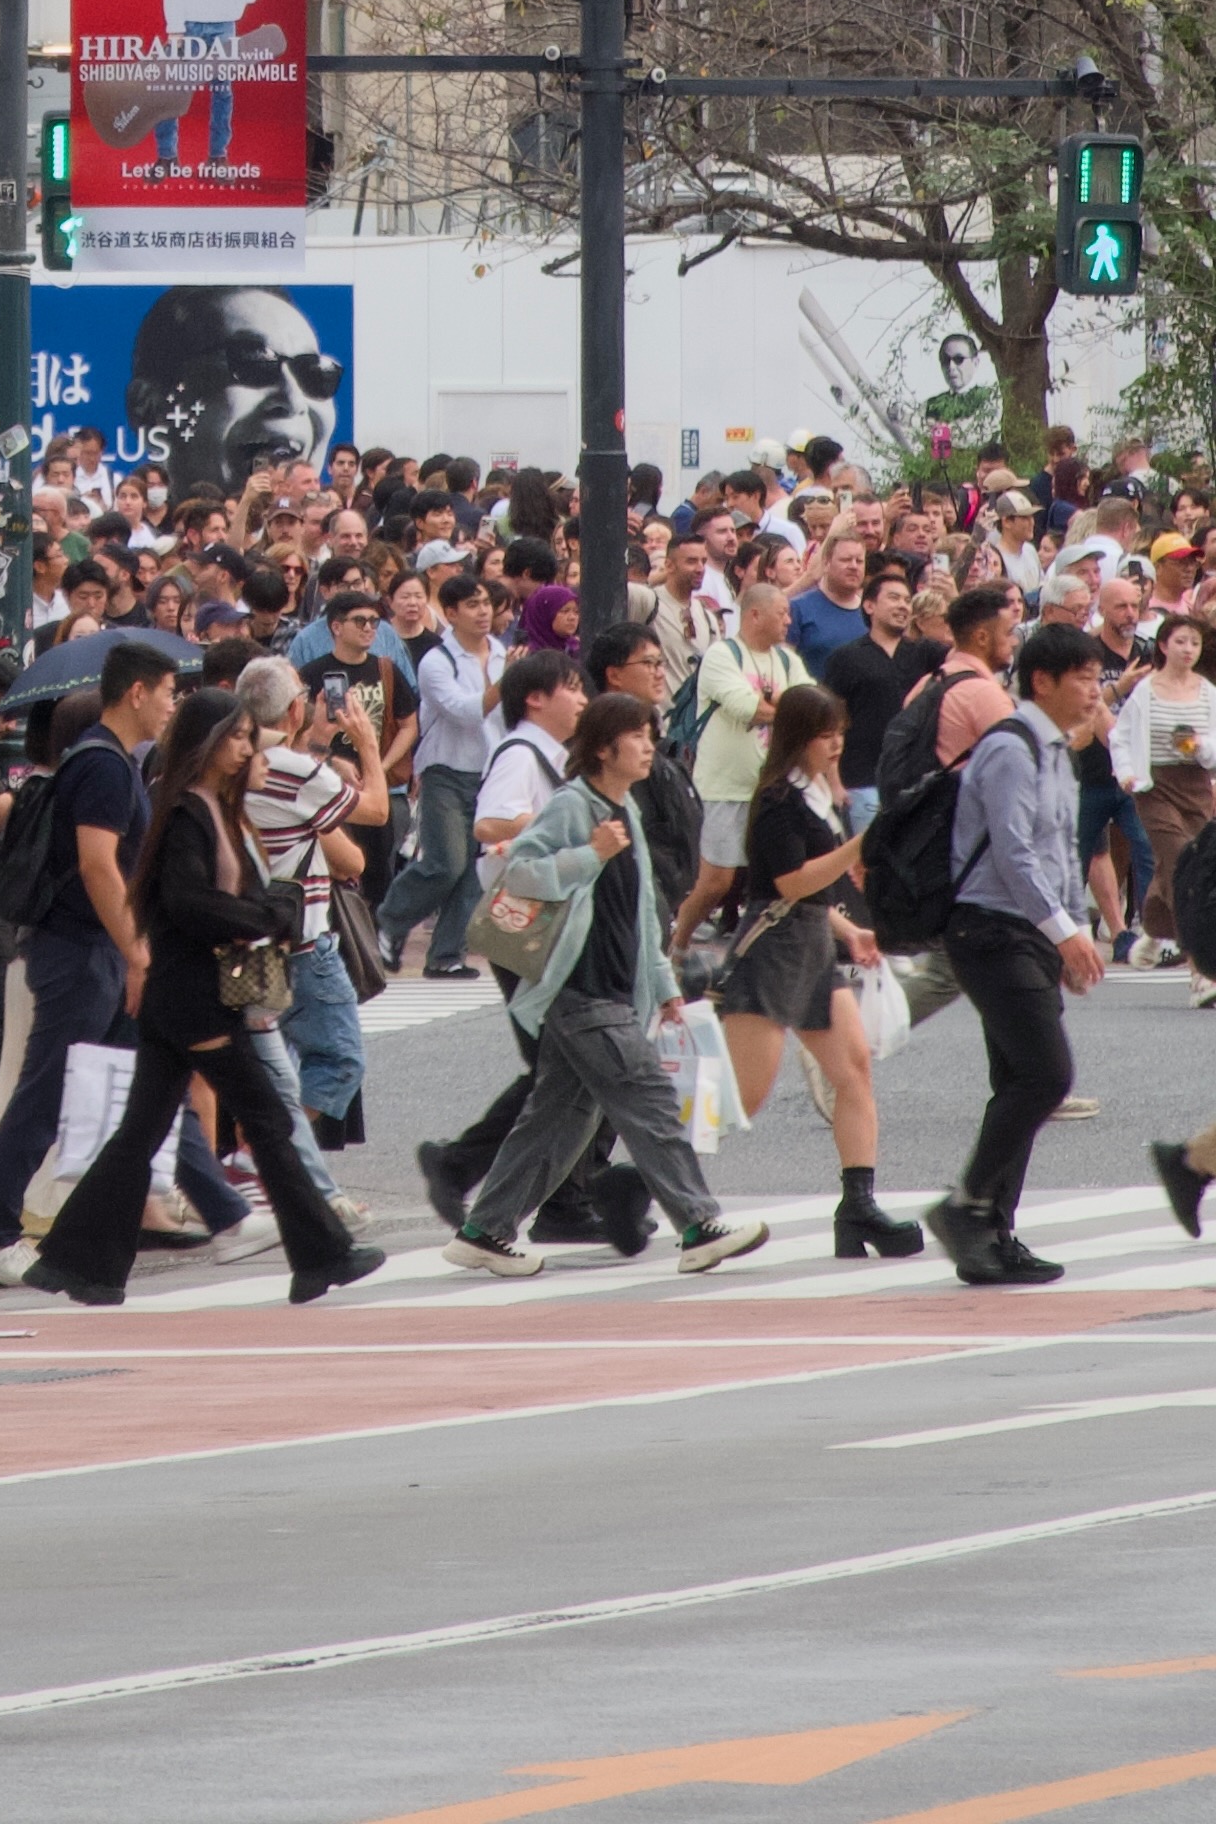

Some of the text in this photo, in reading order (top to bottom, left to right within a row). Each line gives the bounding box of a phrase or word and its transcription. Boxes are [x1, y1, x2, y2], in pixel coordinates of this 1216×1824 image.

[79, 35, 274, 61] HIRAIDAI with
[79, 63, 298, 82] SHIBUYA MUSIC SCRAMBLE
[121, 162, 261, 178] Let's be friends
[80, 230, 297, 250] 渋谷道玄坂商店街振興組合
